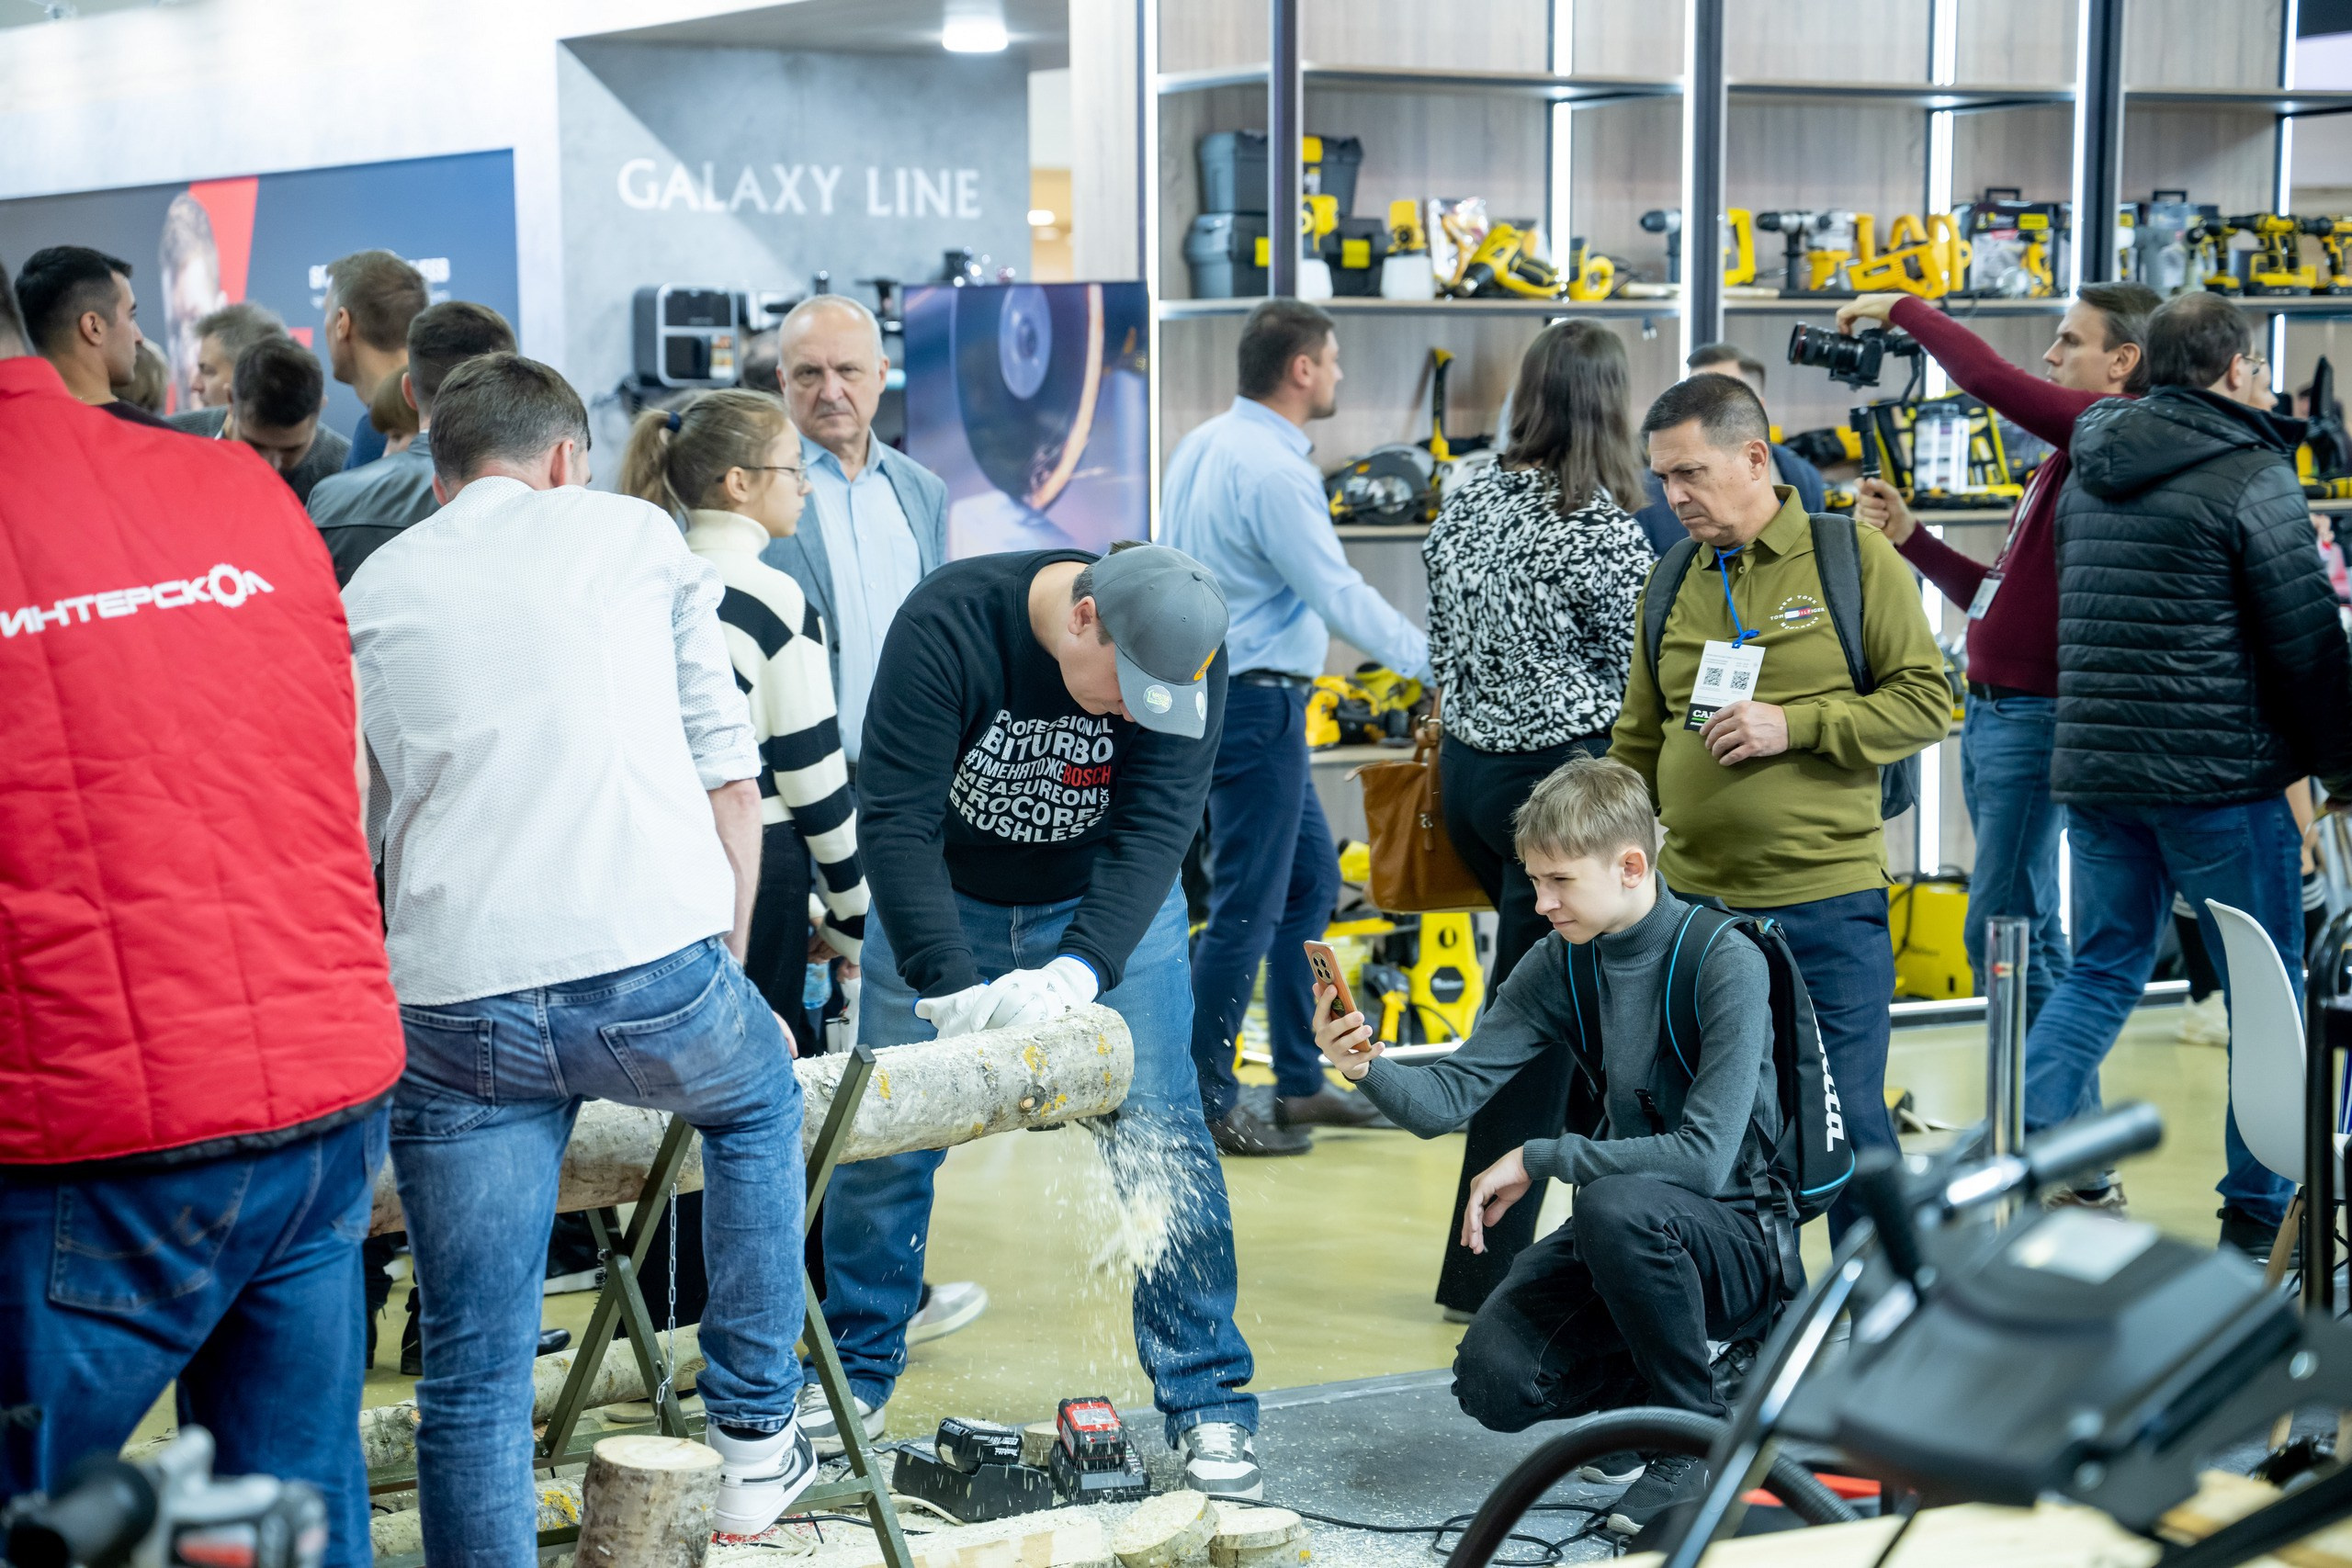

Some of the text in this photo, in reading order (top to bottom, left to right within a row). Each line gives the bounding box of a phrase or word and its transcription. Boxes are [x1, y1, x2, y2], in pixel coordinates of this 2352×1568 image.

[617, 158, 982, 220] GALAXY LINE
[0, 563, 275, 637] ИНТЕРСКОЛ
[981, 725, 1114, 764] BITURBO
[952, 773, 1096, 827] PROCORE
